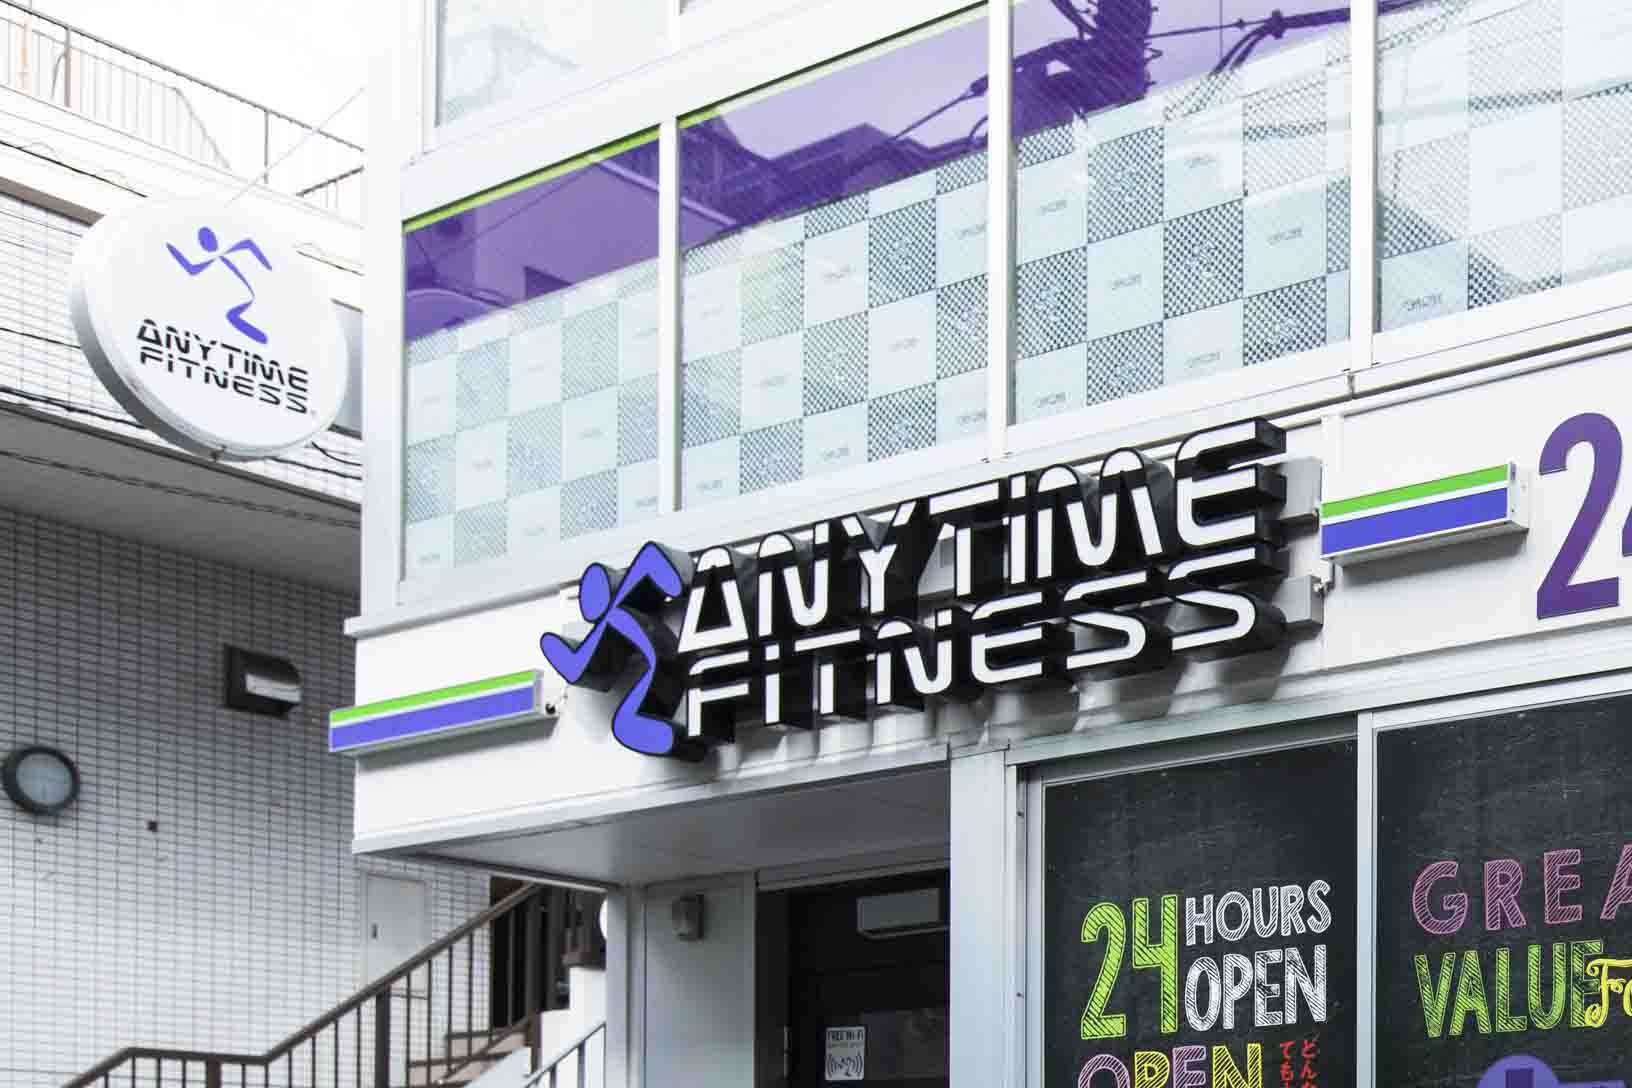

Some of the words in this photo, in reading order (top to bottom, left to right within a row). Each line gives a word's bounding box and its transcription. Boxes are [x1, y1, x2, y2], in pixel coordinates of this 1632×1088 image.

[136, 319, 309, 393] ANYTIME
[139, 346, 308, 414] FITNESS
[677, 418, 1268, 652] ANYTIME
[687, 546, 1262, 737] FITNESS
[1185, 880, 1332, 946] HOURS
[1080, 895, 1178, 1040] 24
[1184, 944, 1328, 1032] OPEN
[1414, 939, 1604, 1038] VALUE
